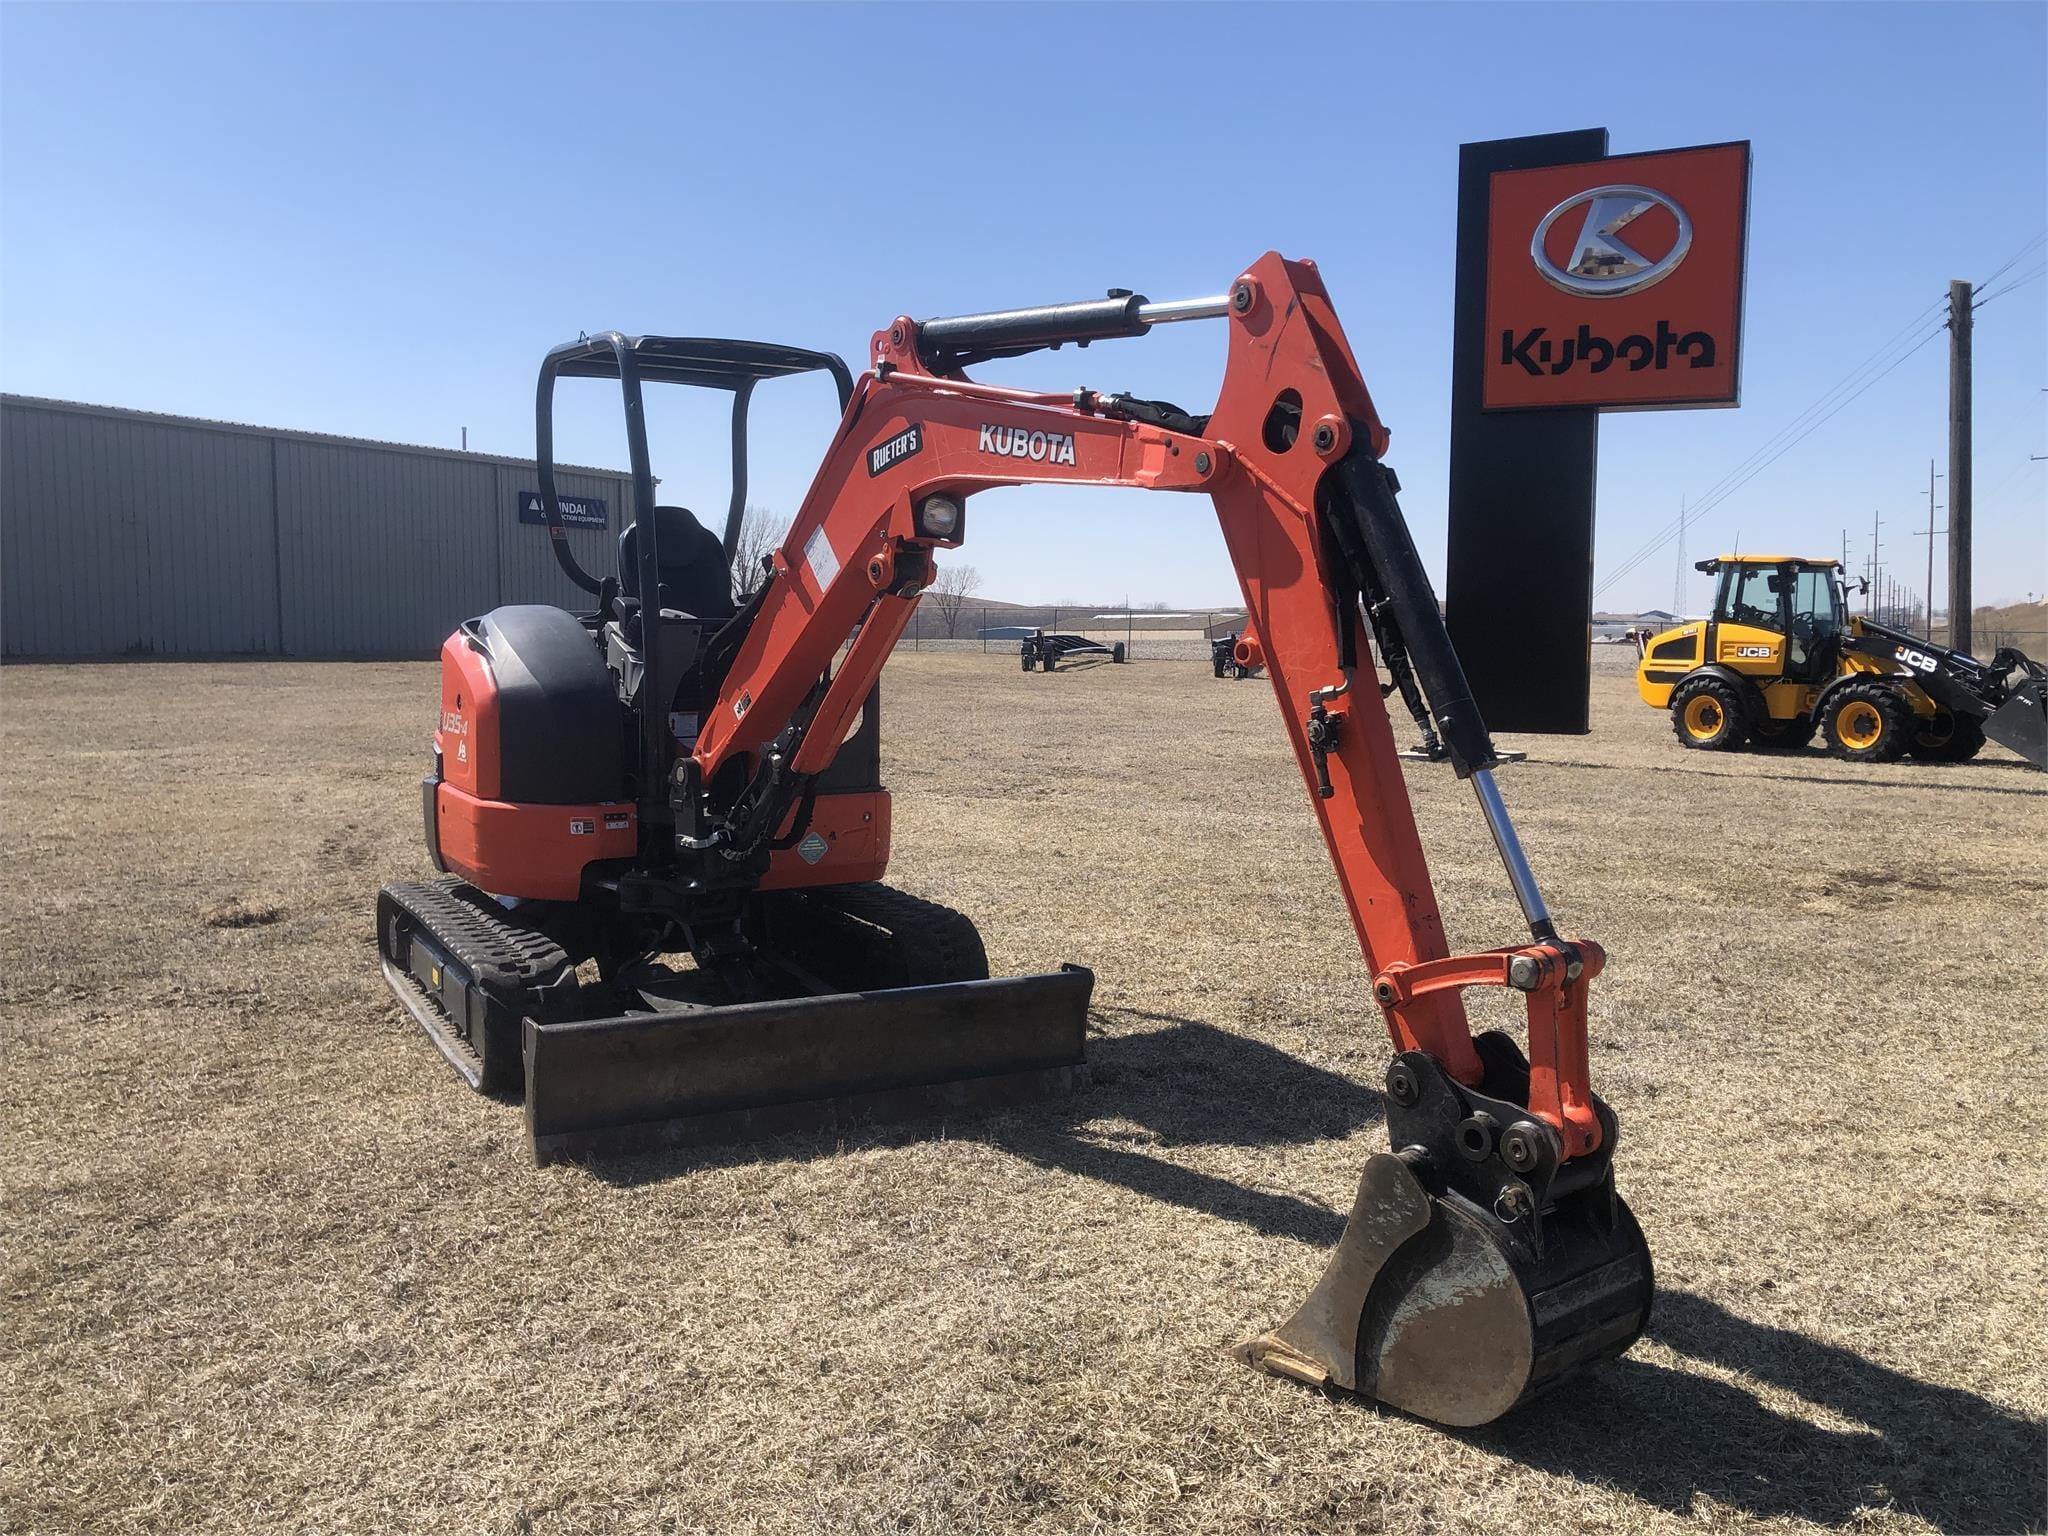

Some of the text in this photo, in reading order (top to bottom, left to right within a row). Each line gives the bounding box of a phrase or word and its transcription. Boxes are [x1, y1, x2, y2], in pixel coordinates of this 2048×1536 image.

[1501, 320, 1716, 377] Kubota
[873, 430, 918, 473] RUETER'S
[978, 423, 1077, 467] KUBOTA
[1737, 647, 1770, 657] JCB
[1895, 646, 1938, 673] JCB
